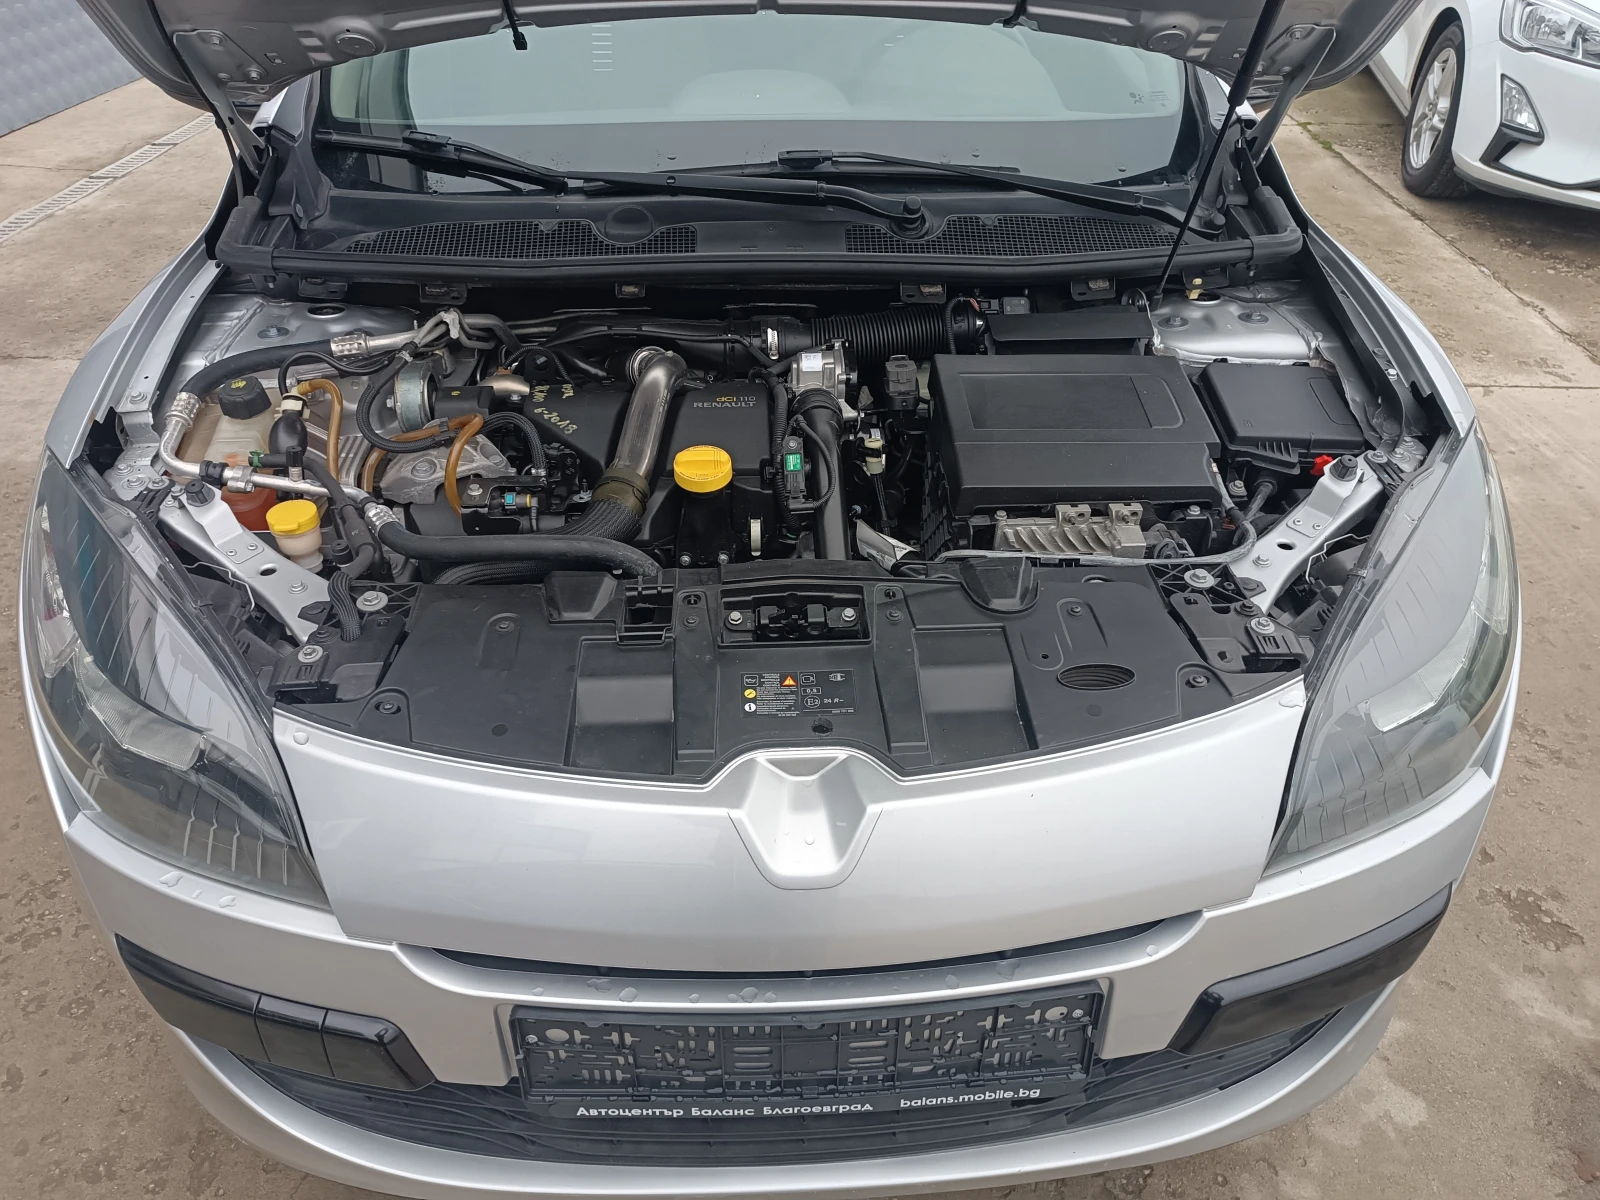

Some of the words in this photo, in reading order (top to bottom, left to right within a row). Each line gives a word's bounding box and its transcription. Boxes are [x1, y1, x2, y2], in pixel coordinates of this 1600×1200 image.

[533, 407, 578, 434] 6-2018
[899, 1088, 1041, 1108] balans.mobile.bg
[576, 1106, 684, 1118] Автоцентър
[691, 1107, 755, 1116] Баланс
[763, 1102, 874, 1116] Благоевград
